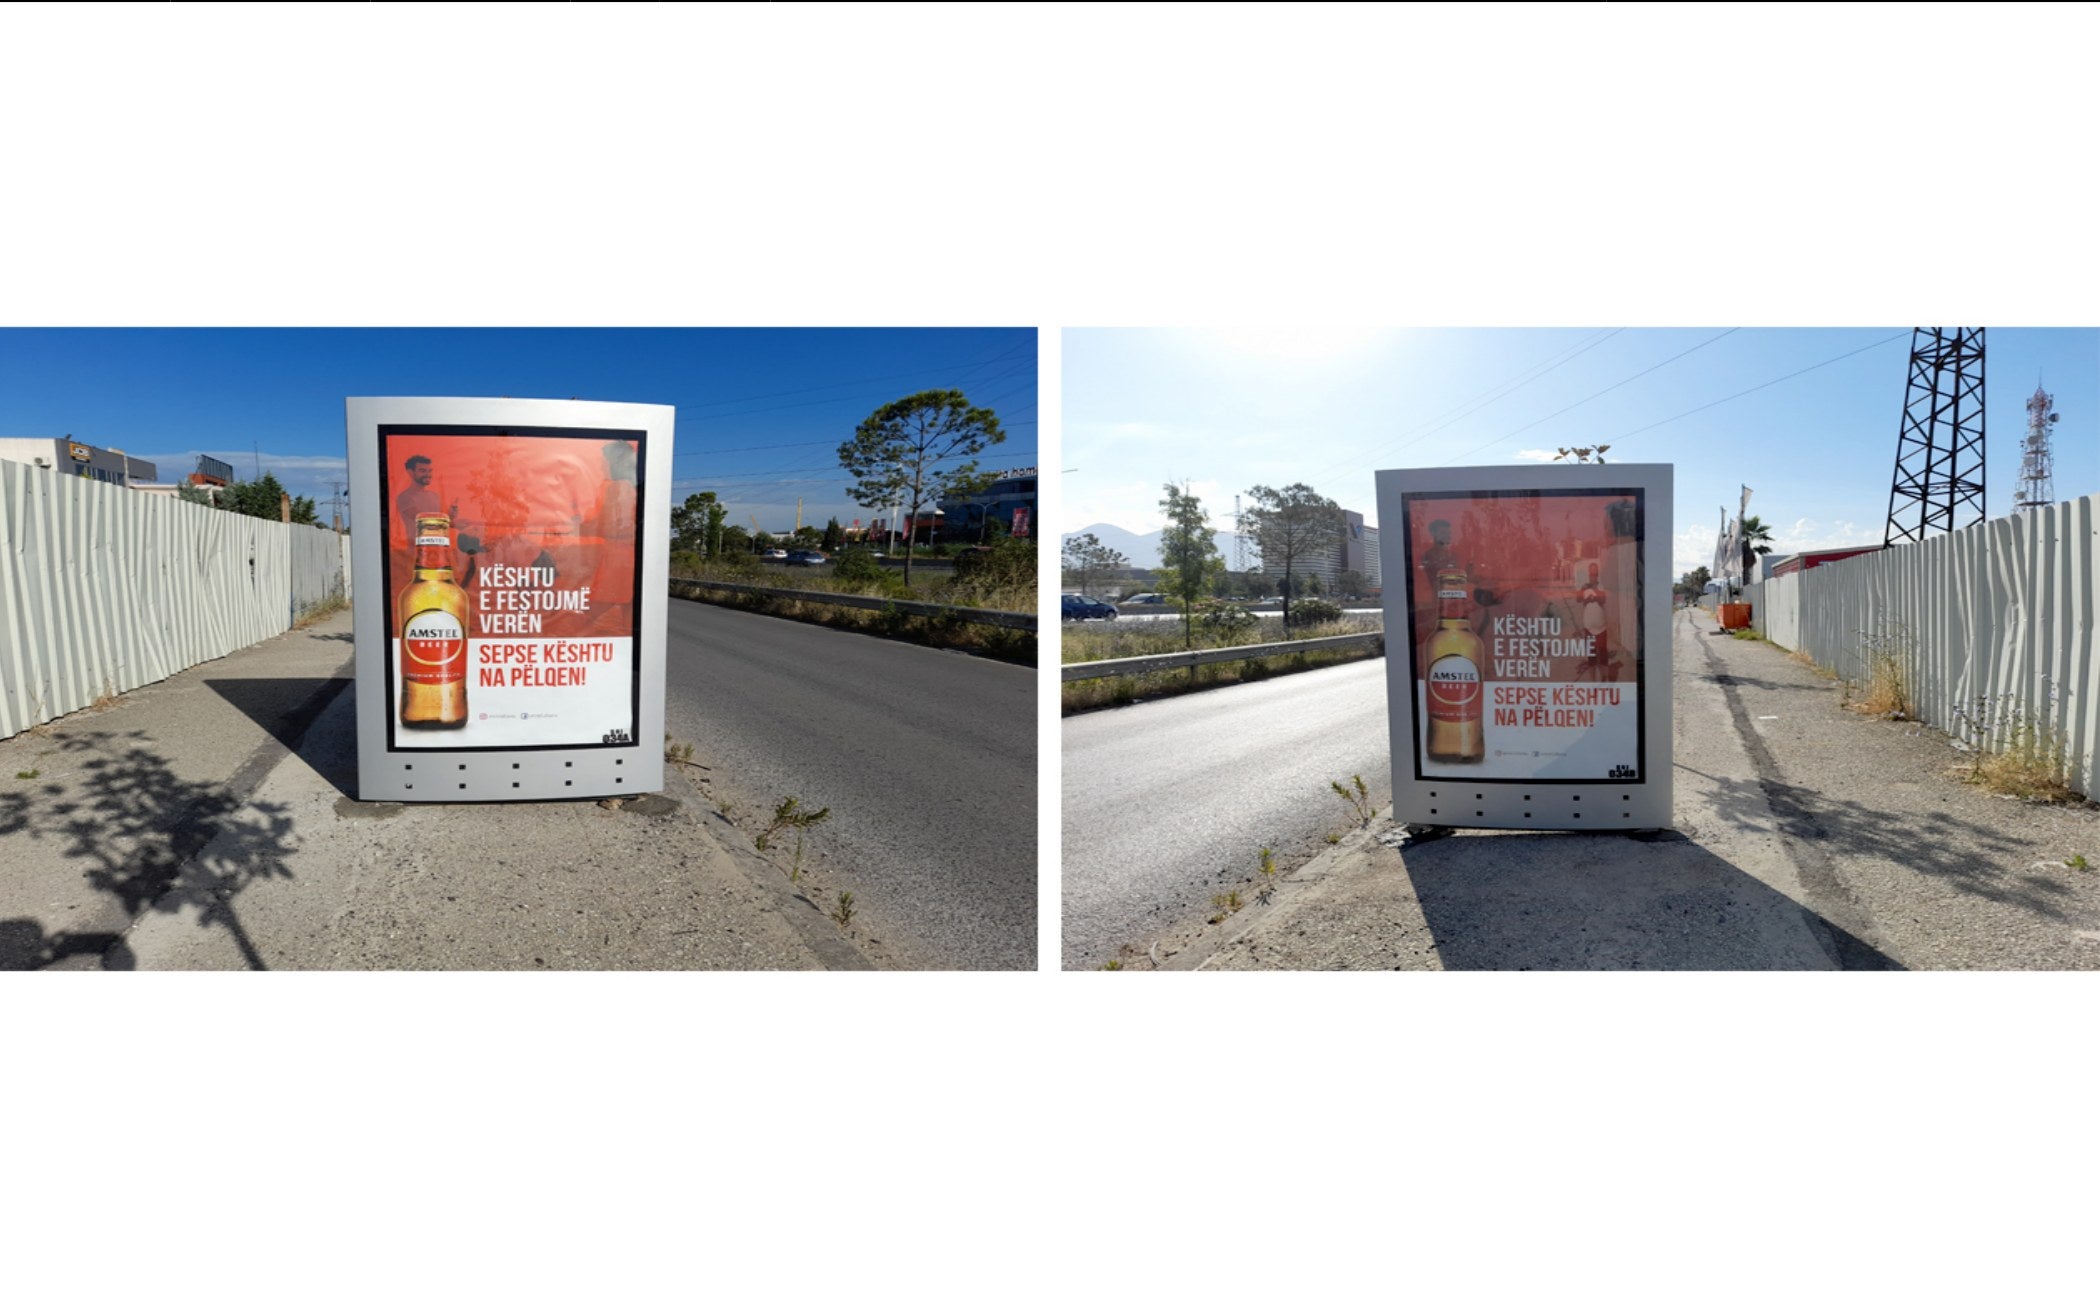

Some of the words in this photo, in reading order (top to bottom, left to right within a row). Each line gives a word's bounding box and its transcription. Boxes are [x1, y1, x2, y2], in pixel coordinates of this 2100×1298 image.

[480, 563, 554, 588] KËSHTU
[480, 590, 491, 611] E
[496, 587, 591, 611] FESTOJMË
[409, 628, 458, 638] AMSTEL
[479, 610, 542, 634] VERËN
[1494, 614, 1561, 636] KËSHTU
[479, 644, 538, 664] SEPSE
[543, 641, 613, 663] KËSHTU
[1494, 638, 1504, 656] E
[1509, 635, 1597, 657] FESTOJMË
[480, 668, 505, 687] NA
[511, 664, 586, 687] PËLQEN!
[1432, 672, 1475, 680] AMSTEL
[1494, 656, 1551, 678] VERËN
[1494, 687, 1547, 705] SEPSE
[1552, 685, 1620, 705] KËSHTU
[1494, 708, 1518, 727] NA
[1523, 705, 1594, 728] PËLQEN!
